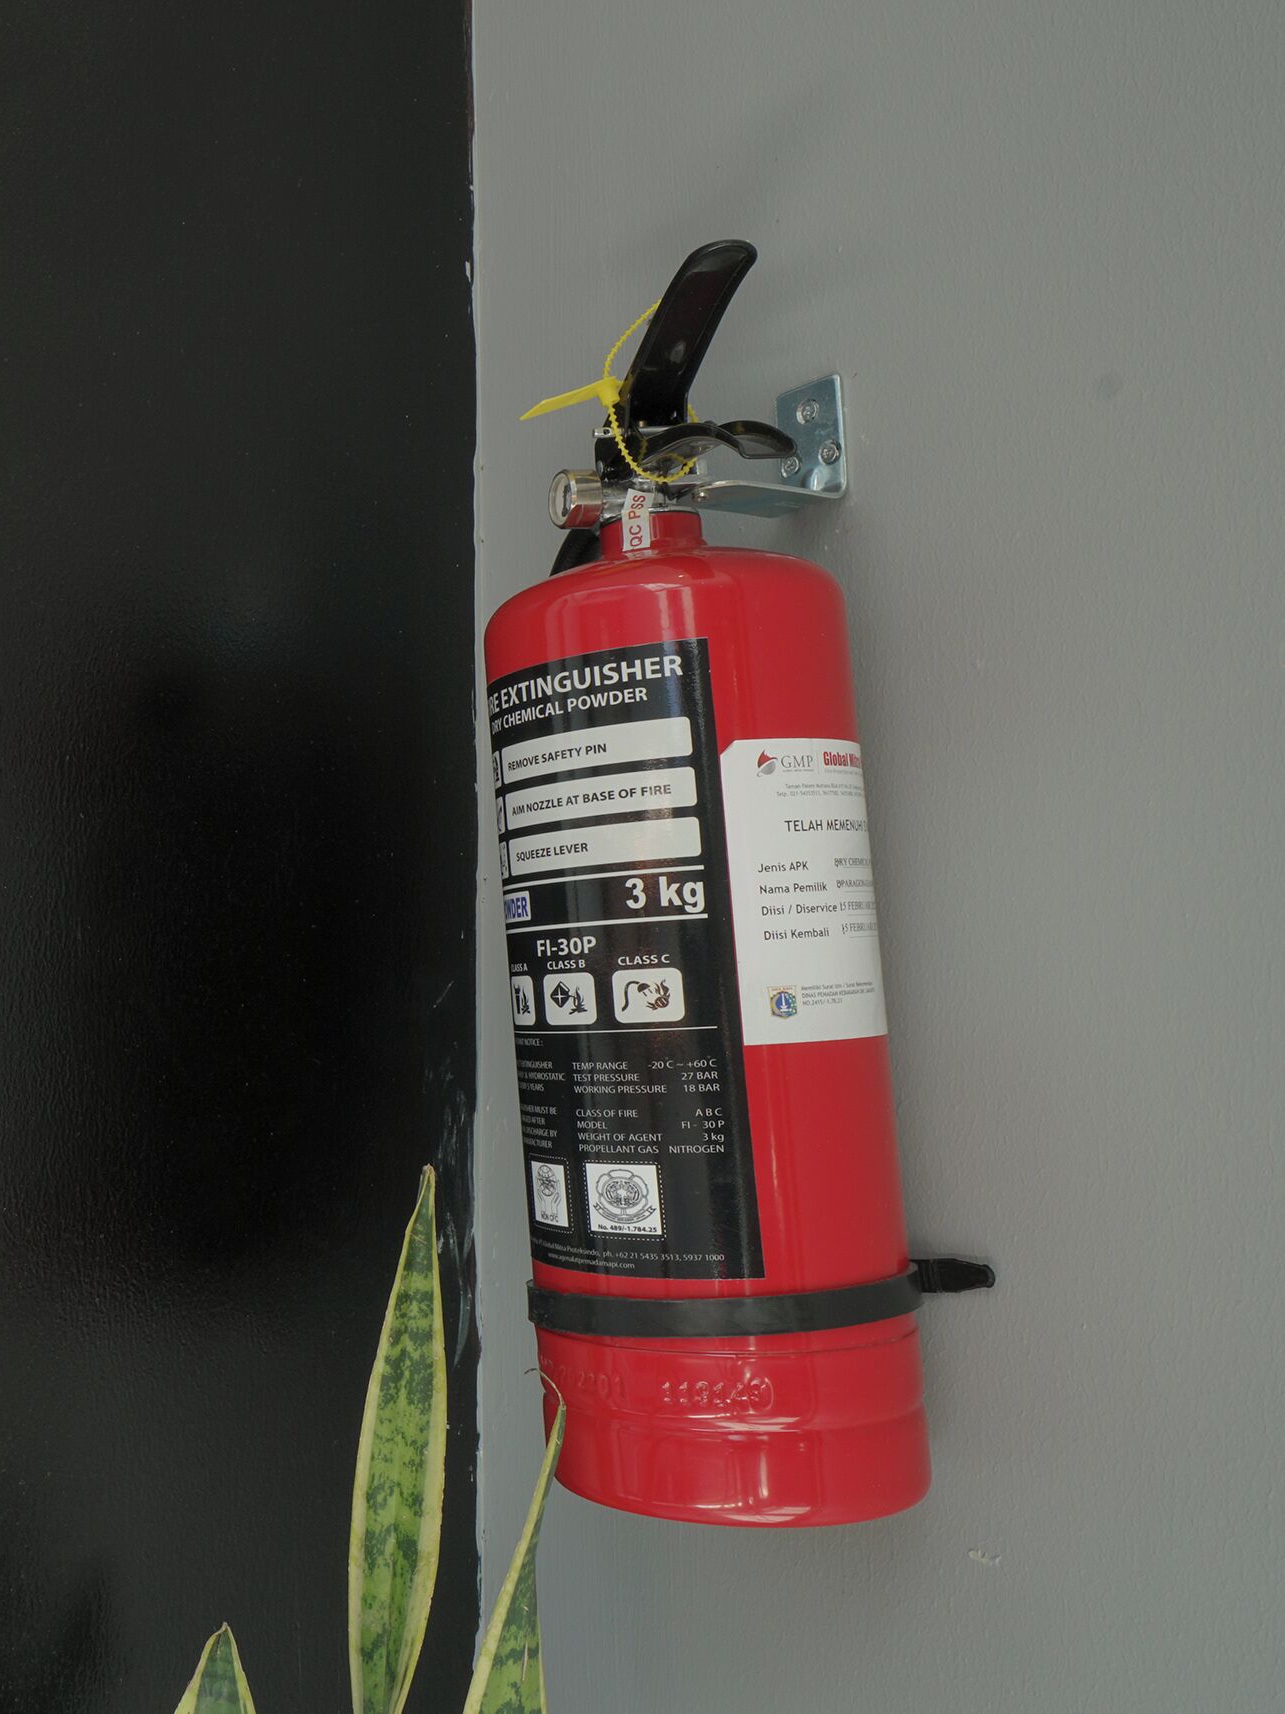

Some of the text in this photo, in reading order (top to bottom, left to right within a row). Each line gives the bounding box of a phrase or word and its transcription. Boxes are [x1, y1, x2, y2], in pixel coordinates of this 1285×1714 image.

[628, 495, 646, 547] QC PSS
[501, 656, 683, 709] EXTINGUISHER
[503, 701, 564, 729] CHEMICAL
[567, 687, 648, 712] POWDER
[508, 743, 607, 771] REMOVE SAFETY PIN
[780, 755, 814, 768] GMP
[823, 751, 848, 767] Global
[512, 784, 672, 816] AIM NOZZLE AT BASE OF FIRE
[784, 819, 823, 832] TELAH
[516, 842, 589, 862] SQUEEZE LEVER
[758, 861, 809, 873] Jenis APK
[759, 881, 828, 895] Nama Pemilik
[625, 876, 705, 914] 3 kg
[761, 905, 785, 916] Diisi
[788, 904, 793, 915] /
[796, 902, 838, 914] Diservice
[764, 930, 787, 941] Diisi
[791, 927, 830, 939] Kembali
[536, 936, 597, 958] FI-30P
[547, 959, 586, 971] CLASS B
[618, 954, 671, 966] CLASS C
[523, 962, 529, 971] A
[572, 1062, 595, 1070] TEMP
[596, 1061, 629, 1070] RANGE
[573, 1071, 719, 1082] TEST PRESSURE 27 BAR
[574, 1083, 721, 1094] WORKING PRESSURE 18 BAR
[576, 1107, 723, 1118] CLASS OF FIRE A B C
[577, 1120, 608, 1130] MODEL
[681, 1121, 691, 1129] FI
[702, 1120, 716, 1129] 30
[718, 1120, 725, 1128] P
[549, 1129, 558, 1138] BY
[578, 1132, 724, 1143] WEIGHT OF AGENT 3 kg
[579, 1143, 725, 1154] PROPELLANT GAS NITROGEN
[602, 1250, 613, 1259] ph.
[615, 1251, 629, 1259] +62
[640, 1252, 659, 1260] 5435
[683, 1254, 703, 1262] 5937
[705, 1254, 725, 1262] 1000
